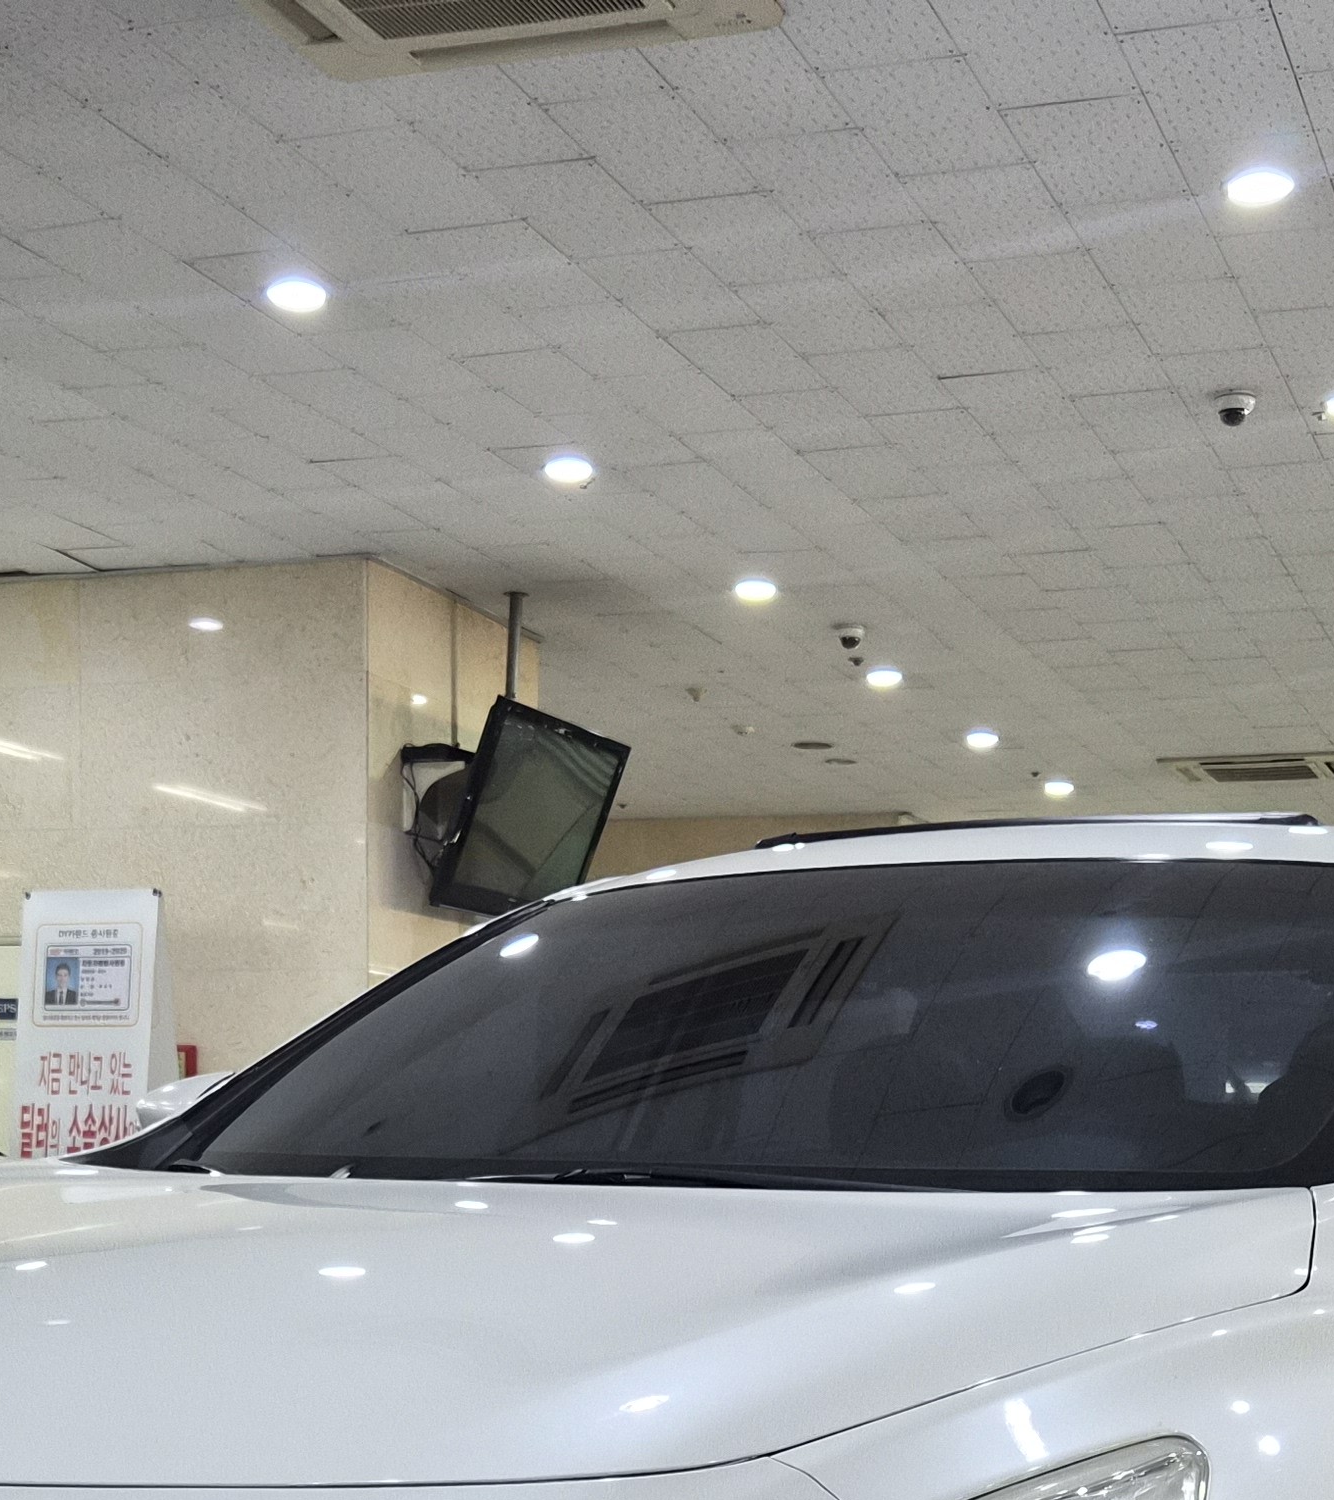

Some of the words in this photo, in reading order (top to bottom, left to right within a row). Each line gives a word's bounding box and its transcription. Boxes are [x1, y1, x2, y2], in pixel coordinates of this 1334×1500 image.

[39, 1051, 62, 1096] 지금
[68, 1051, 104, 1096] 만나고
[109, 1051, 133, 1096] 있는
[20, 1102, 61, 1159] 딜러의
